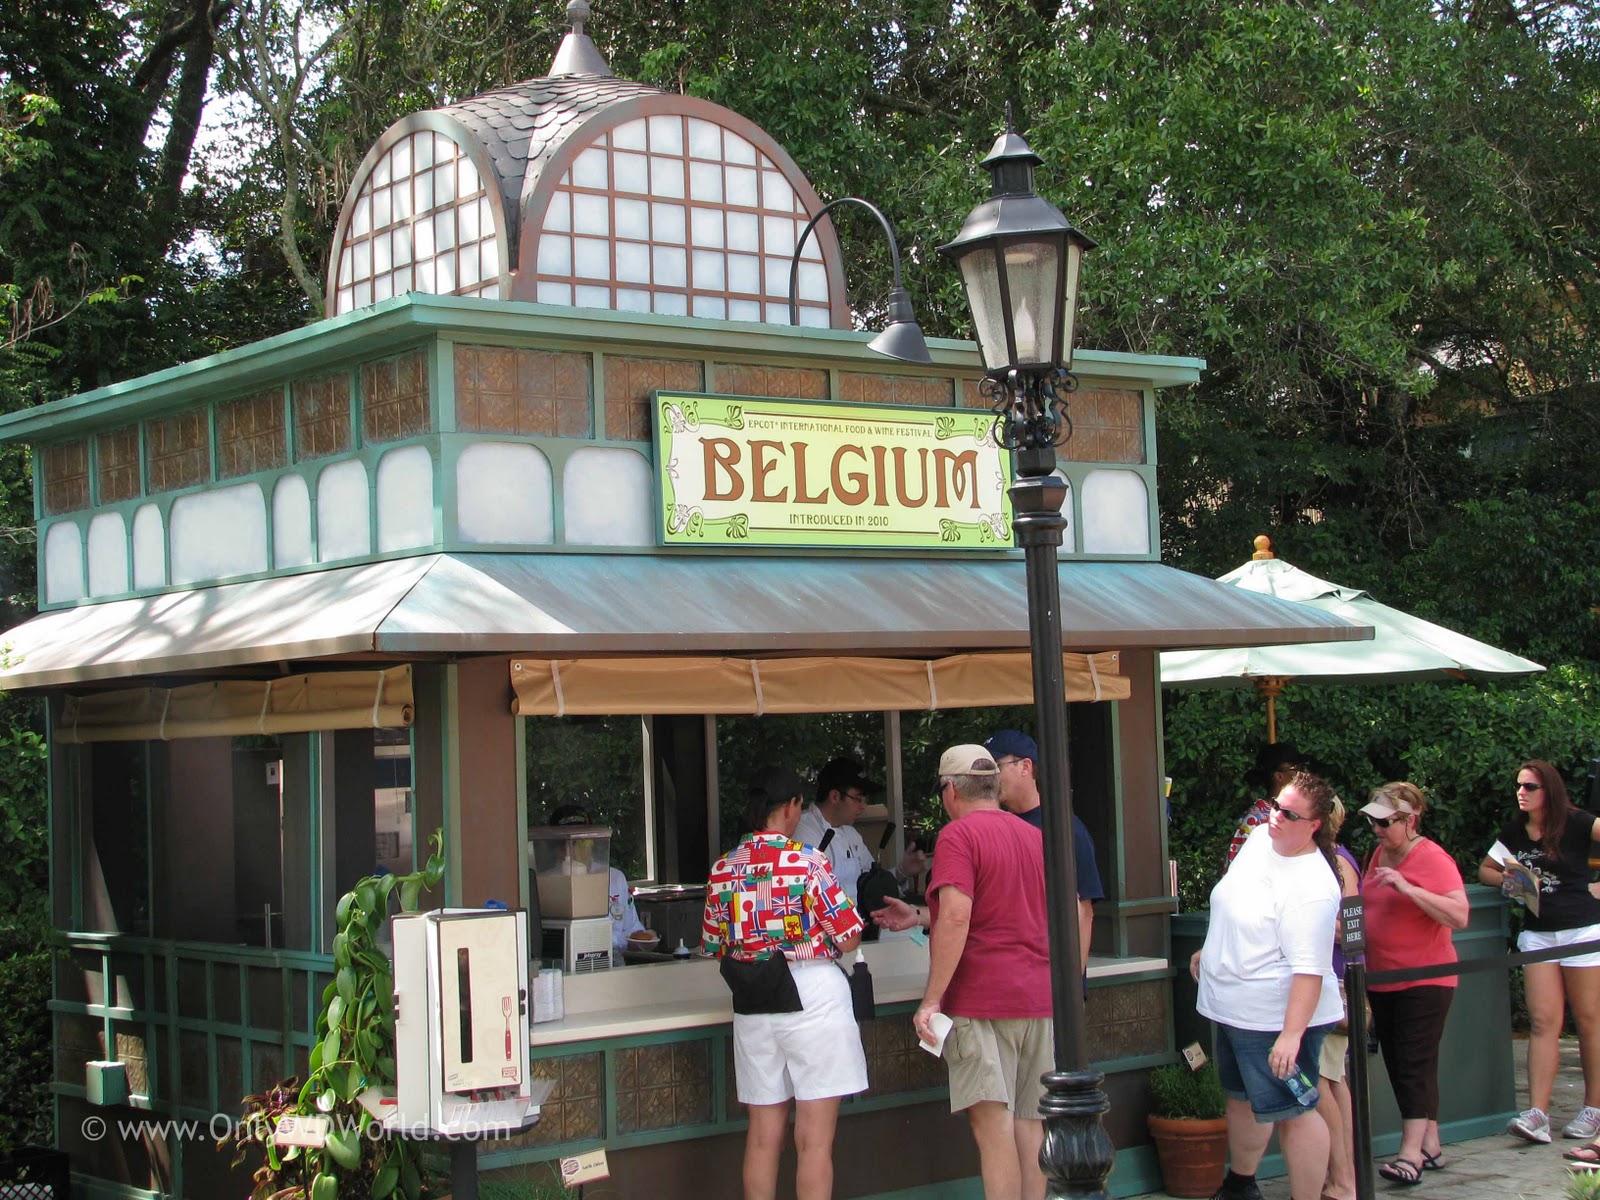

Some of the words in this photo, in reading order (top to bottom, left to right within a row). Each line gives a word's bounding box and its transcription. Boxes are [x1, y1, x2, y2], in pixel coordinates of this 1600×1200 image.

[780, 421, 843, 433] INTERNATIONAL
[845, 424, 866, 435] FOOD
[867, 426, 873, 435] &
[874, 426, 894, 436] WINE
[896, 427, 932, 438] FESTIVAL
[698, 437, 981, 509] BELGIUM
[789, 513, 853, 526] INTRODUCED
[855, 515, 865, 526] IN
[867, 516, 889, 527] 2010
[1343, 905, 1363, 918] PLEASE
[1347, 918, 1360, 930] EXIT
[1346, 930, 1362, 942] HERE
